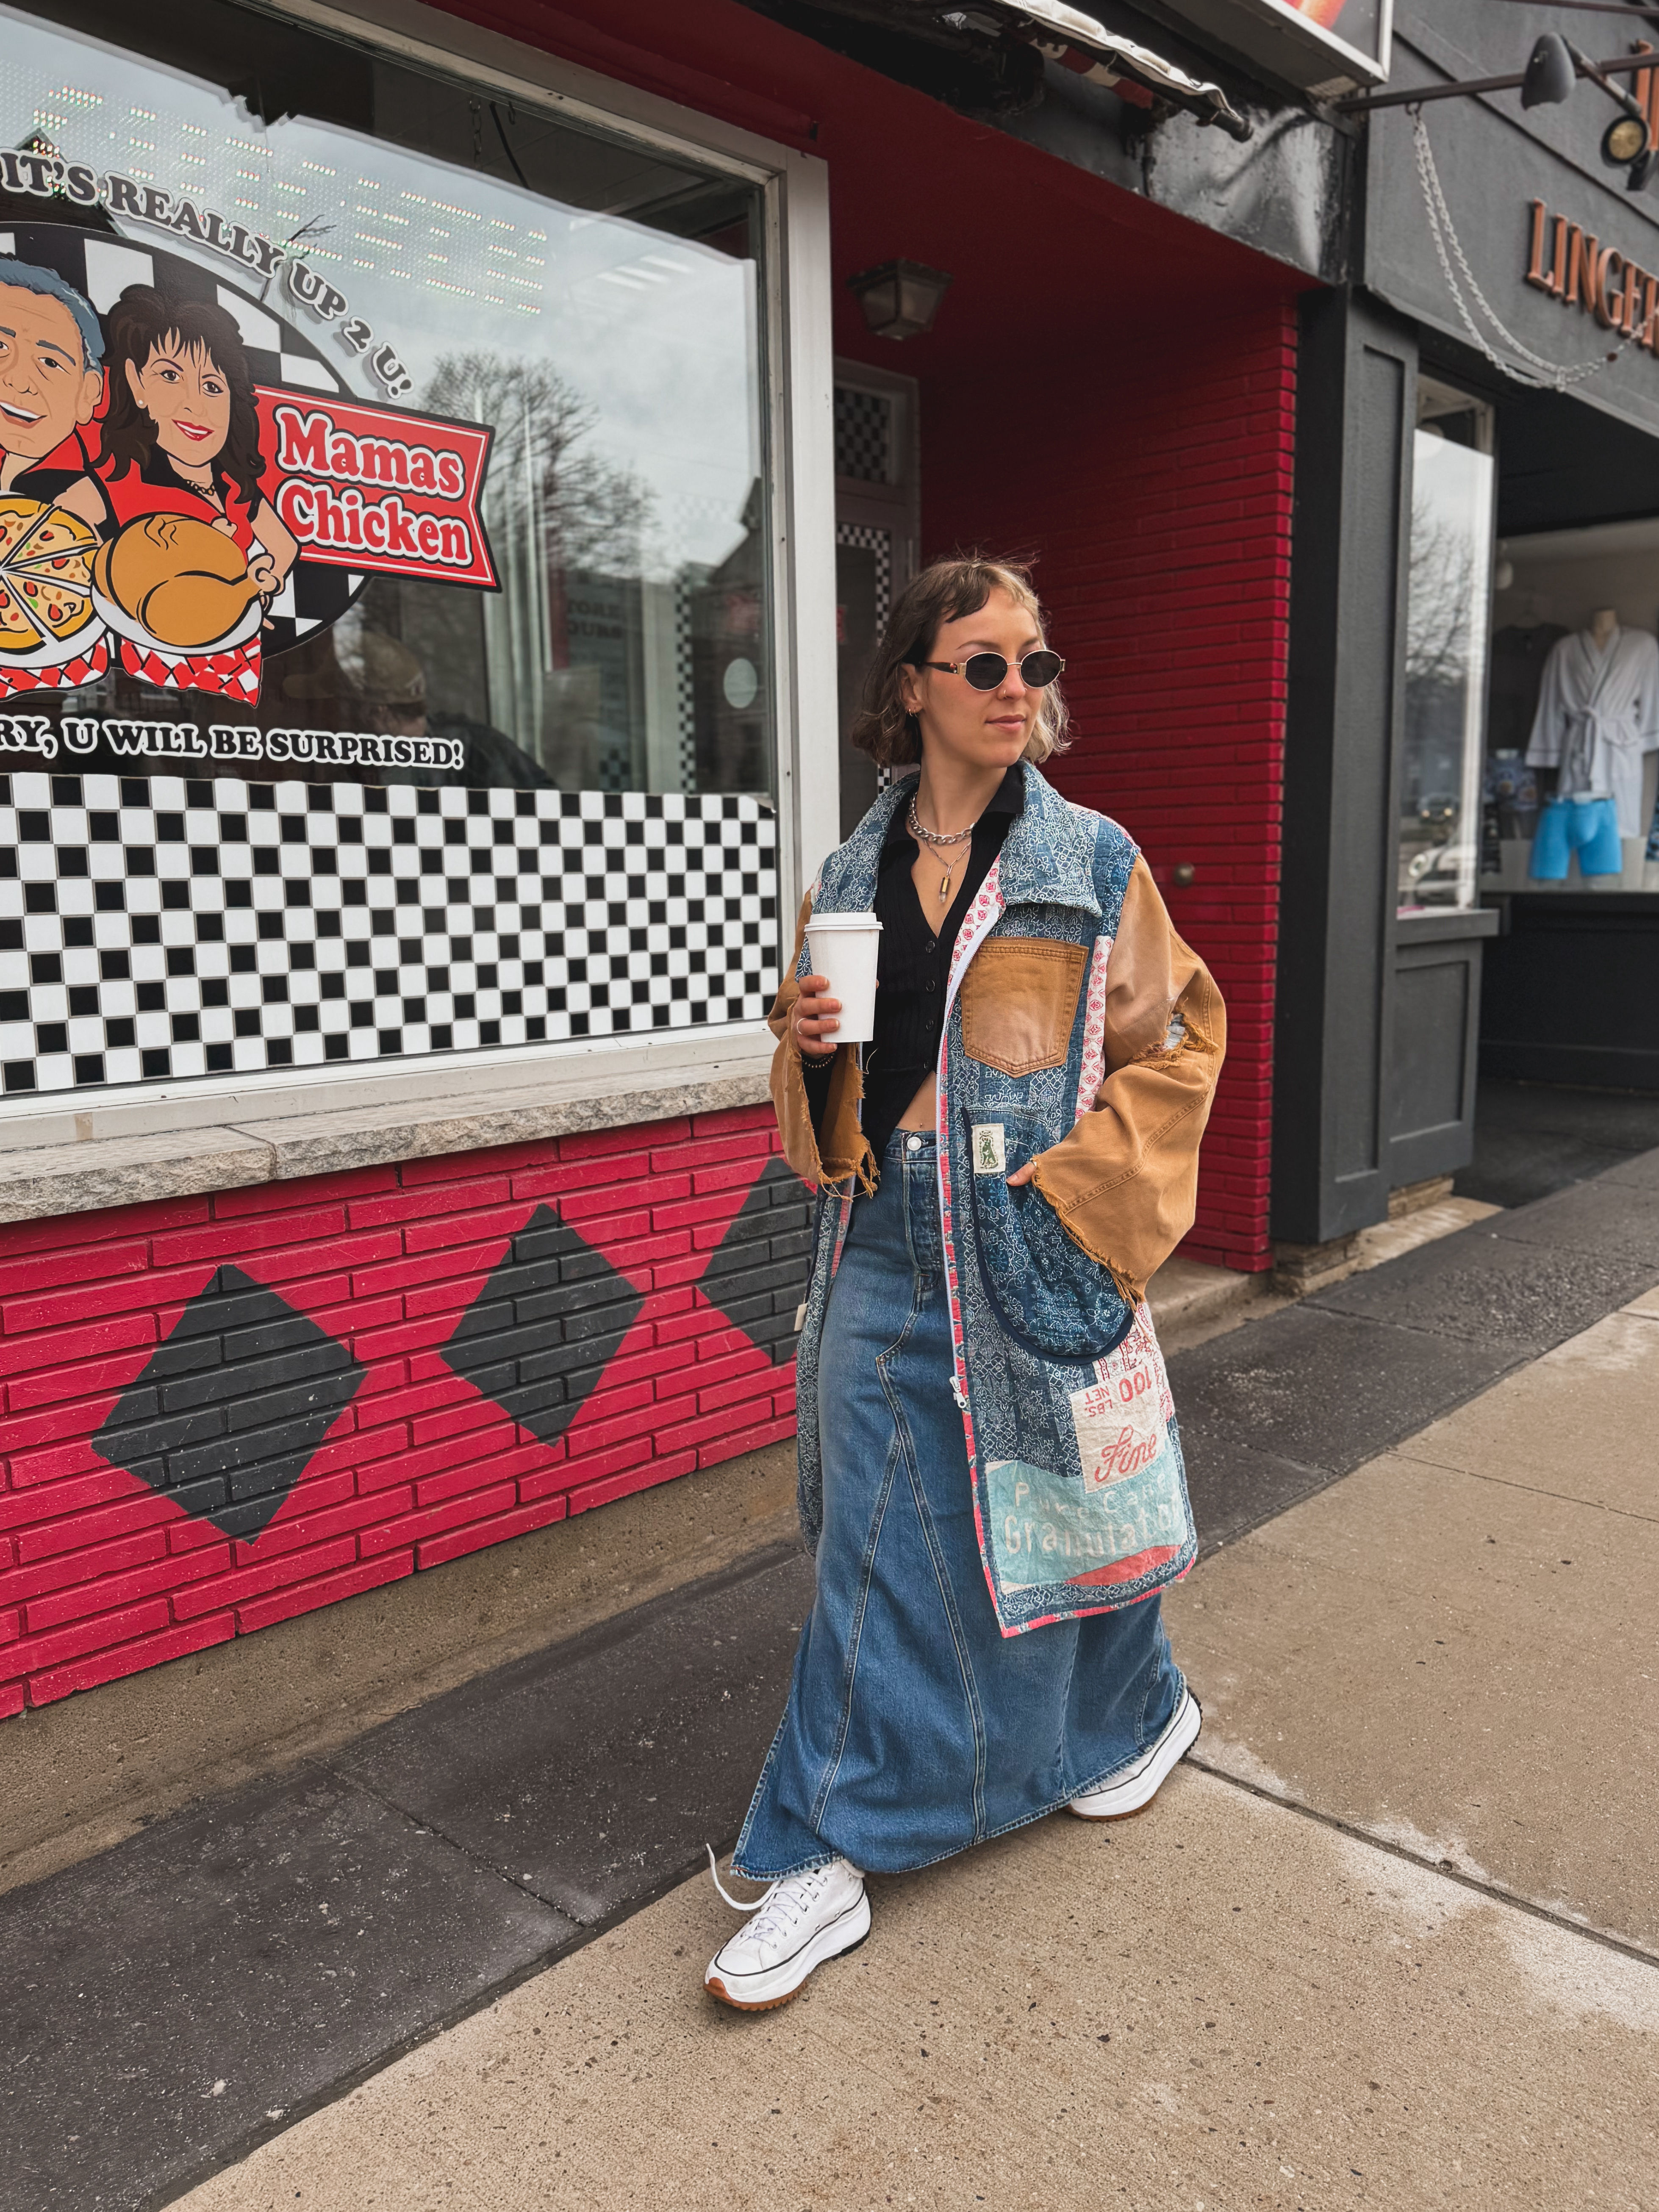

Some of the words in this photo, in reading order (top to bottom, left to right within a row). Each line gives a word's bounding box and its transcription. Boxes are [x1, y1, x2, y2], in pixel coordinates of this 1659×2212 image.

[0, 150, 97, 203] IT'S
[106, 174, 285, 275] REALLY
[290, 261, 347, 318] UP
[344, 318, 372, 352] 2
[375, 343, 413, 397] U!
[279, 410, 463, 495] Mamas
[279, 483, 470, 563] Chicken
[0, 717, 56, 757] RY,
[63, 720, 97, 751] U
[104, 721, 206, 754] WILL
[212, 728, 260, 757] BE
[267, 729, 463, 767] SURPRISED!
[1085, 1386, 1109, 1405] NET
[1119, 1366, 1152, 1402] 100
[1094, 1424, 1157, 1482] Fine
[1103, 1473, 1165, 1513] Cane
